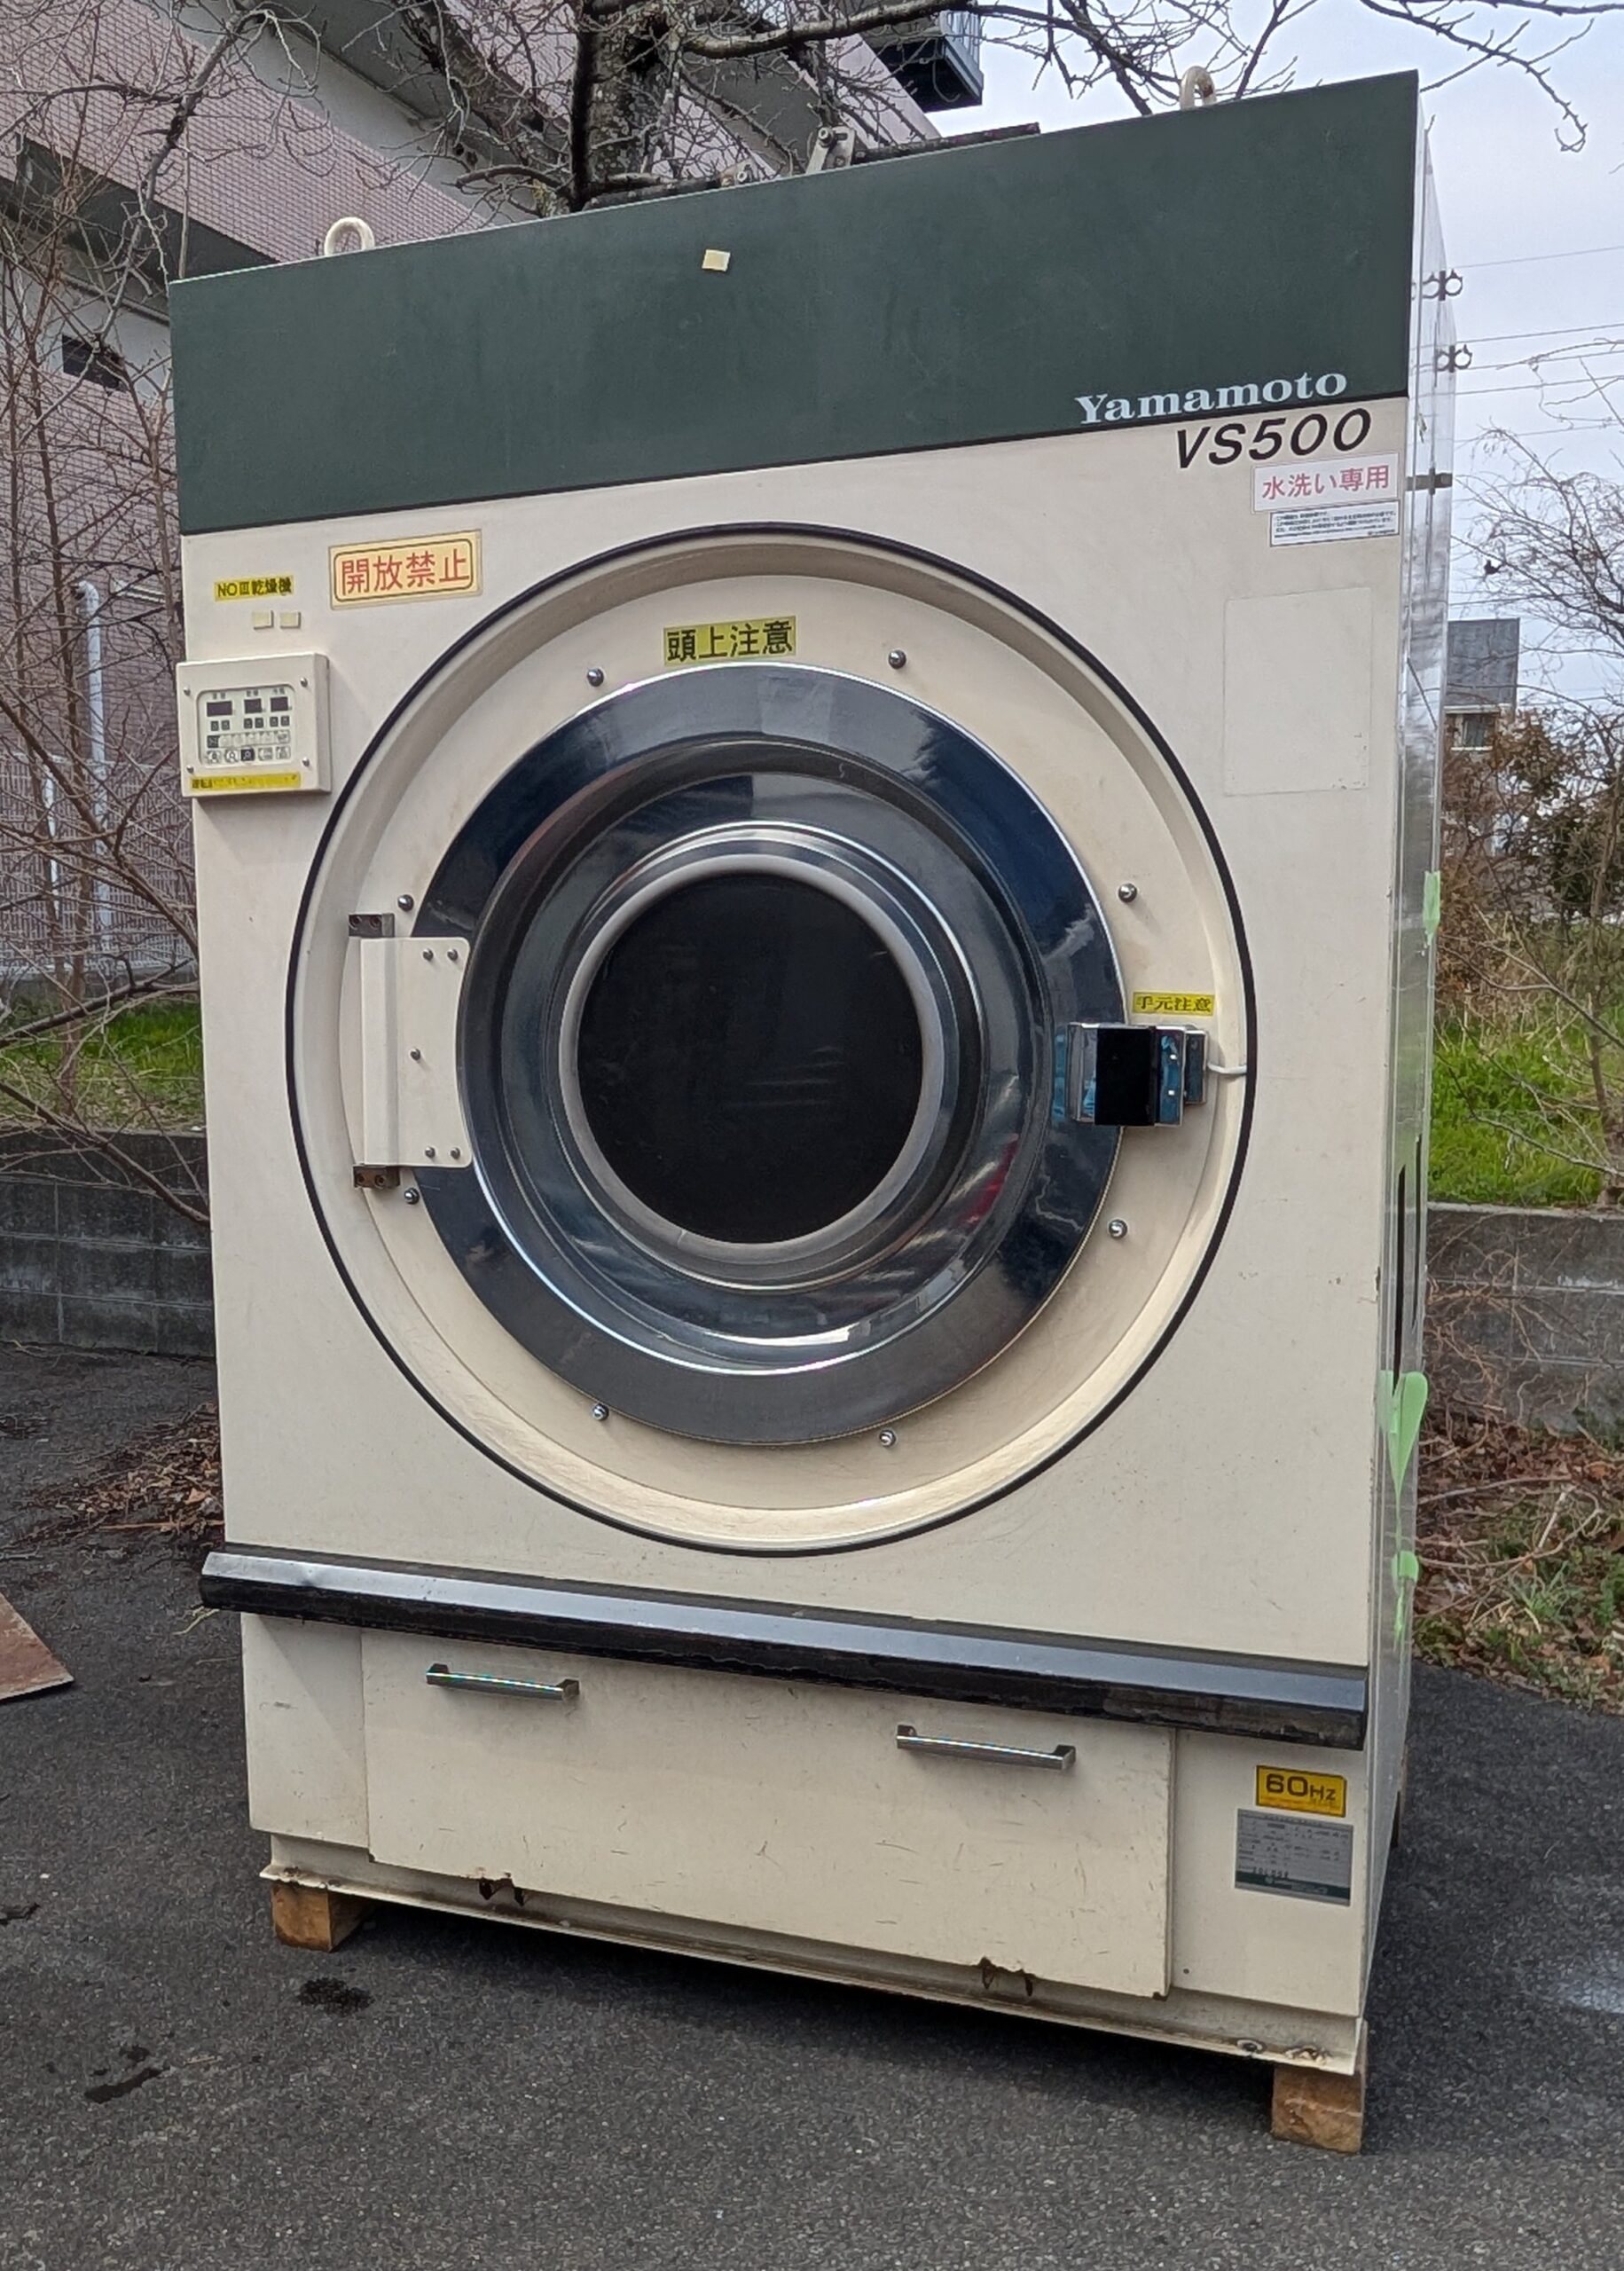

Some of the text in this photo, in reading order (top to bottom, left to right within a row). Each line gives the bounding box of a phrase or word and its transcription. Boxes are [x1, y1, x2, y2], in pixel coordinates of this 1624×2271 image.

[1075, 372, 1348, 425] Yamamoto
[1176, 407, 1372, 469] VS500
[1261, 465, 1391, 500] 水洗い専用
[341, 548, 470, 596] 開放禁止
[667, 620, 792, 662] 頭上注意
